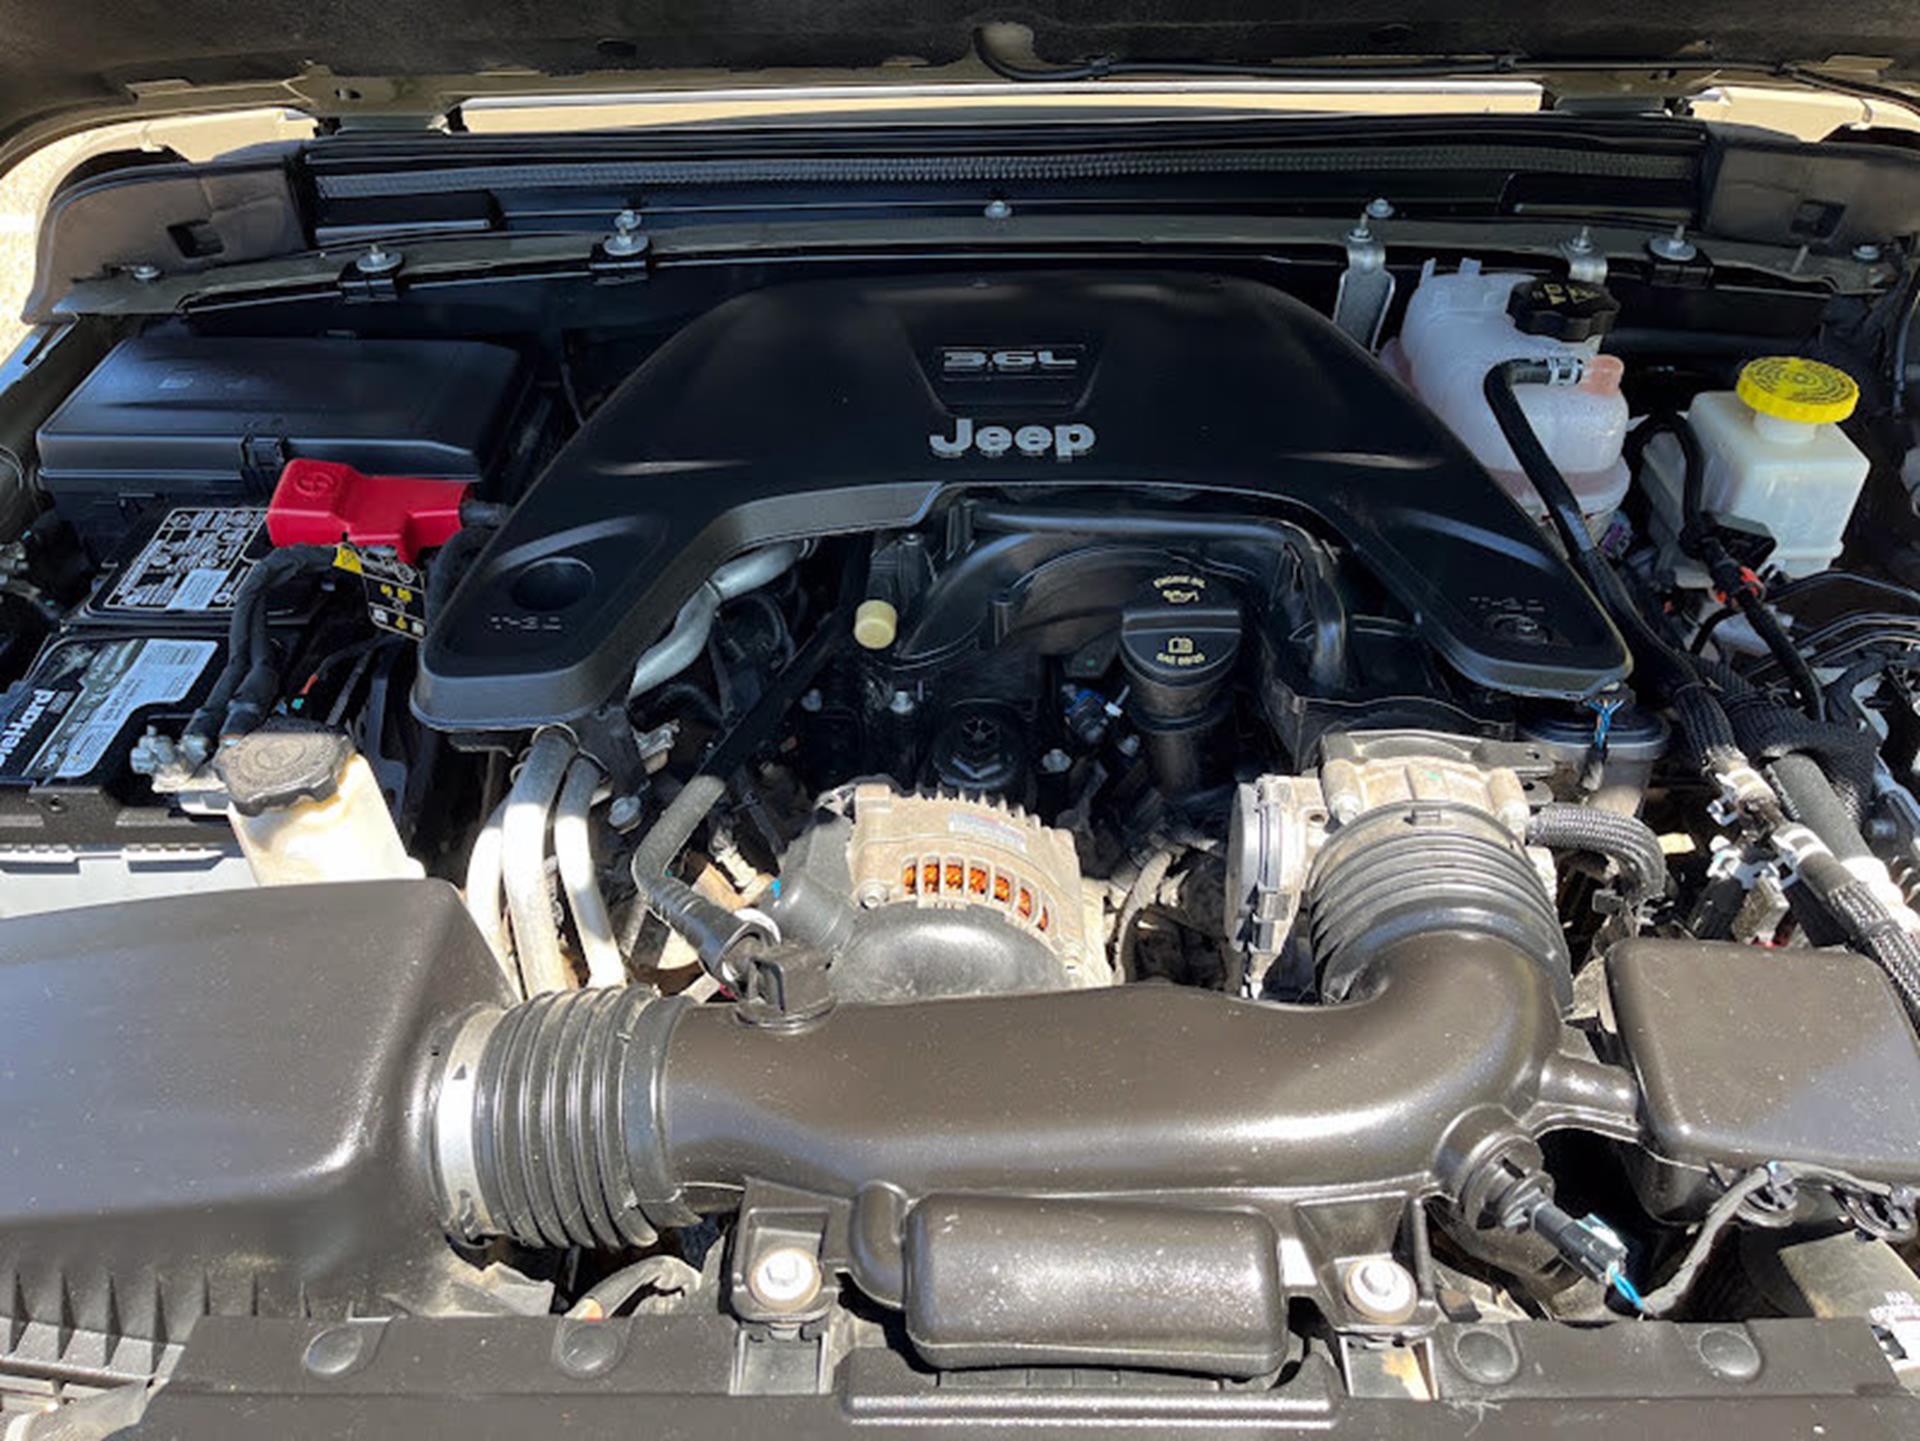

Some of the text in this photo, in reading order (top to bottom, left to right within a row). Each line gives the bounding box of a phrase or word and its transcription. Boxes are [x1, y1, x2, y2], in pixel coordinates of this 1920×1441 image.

[943, 351, 1078, 371] 3.6L
[929, 418, 1096, 462] Jeep
[1190, 577, 1206, 589] OIL
[0, 689, 58, 767] ieHard
